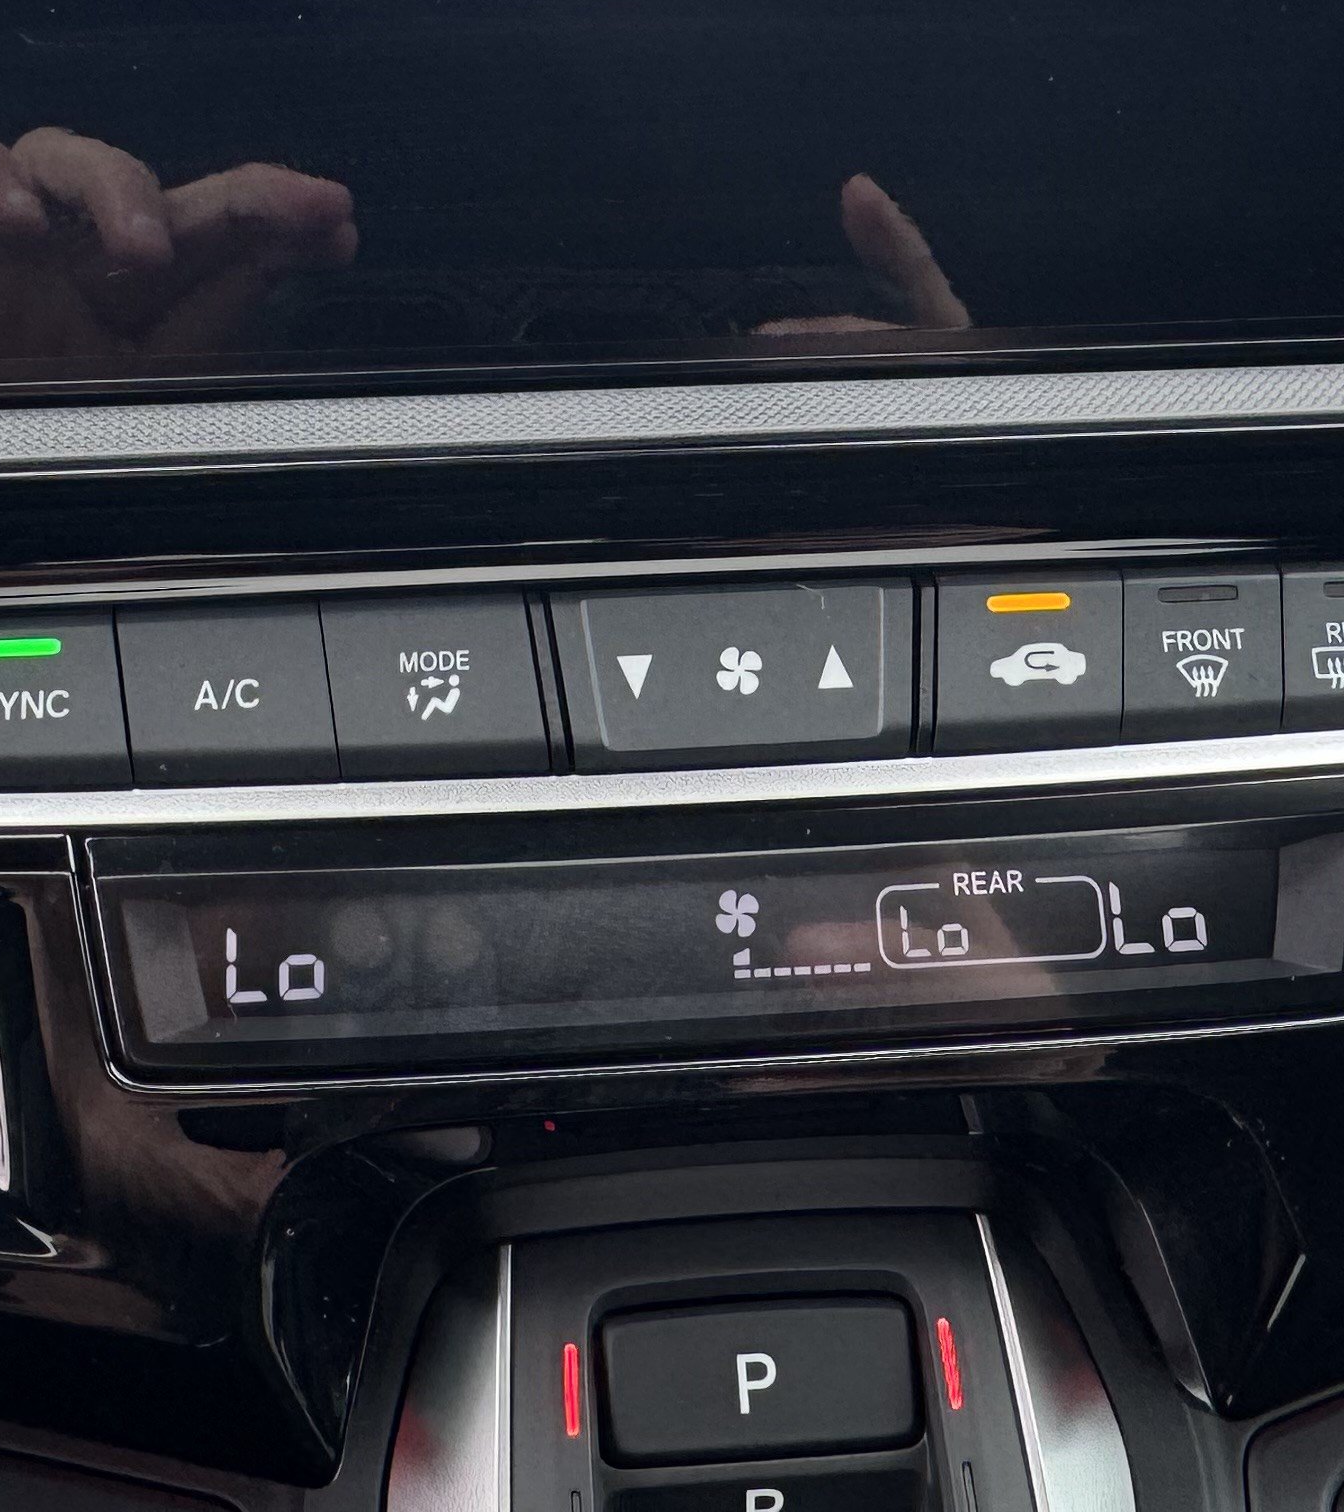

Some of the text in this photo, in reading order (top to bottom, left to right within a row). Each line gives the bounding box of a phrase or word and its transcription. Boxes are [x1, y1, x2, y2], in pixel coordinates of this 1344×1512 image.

[1161, 626, 1246, 653] FRONT
[398, 649, 471, 674] MODE
[193, 677, 261, 712] A/C
[952, 869, 1024, 896] REAR
[735, 1352, 778, 1415] P
